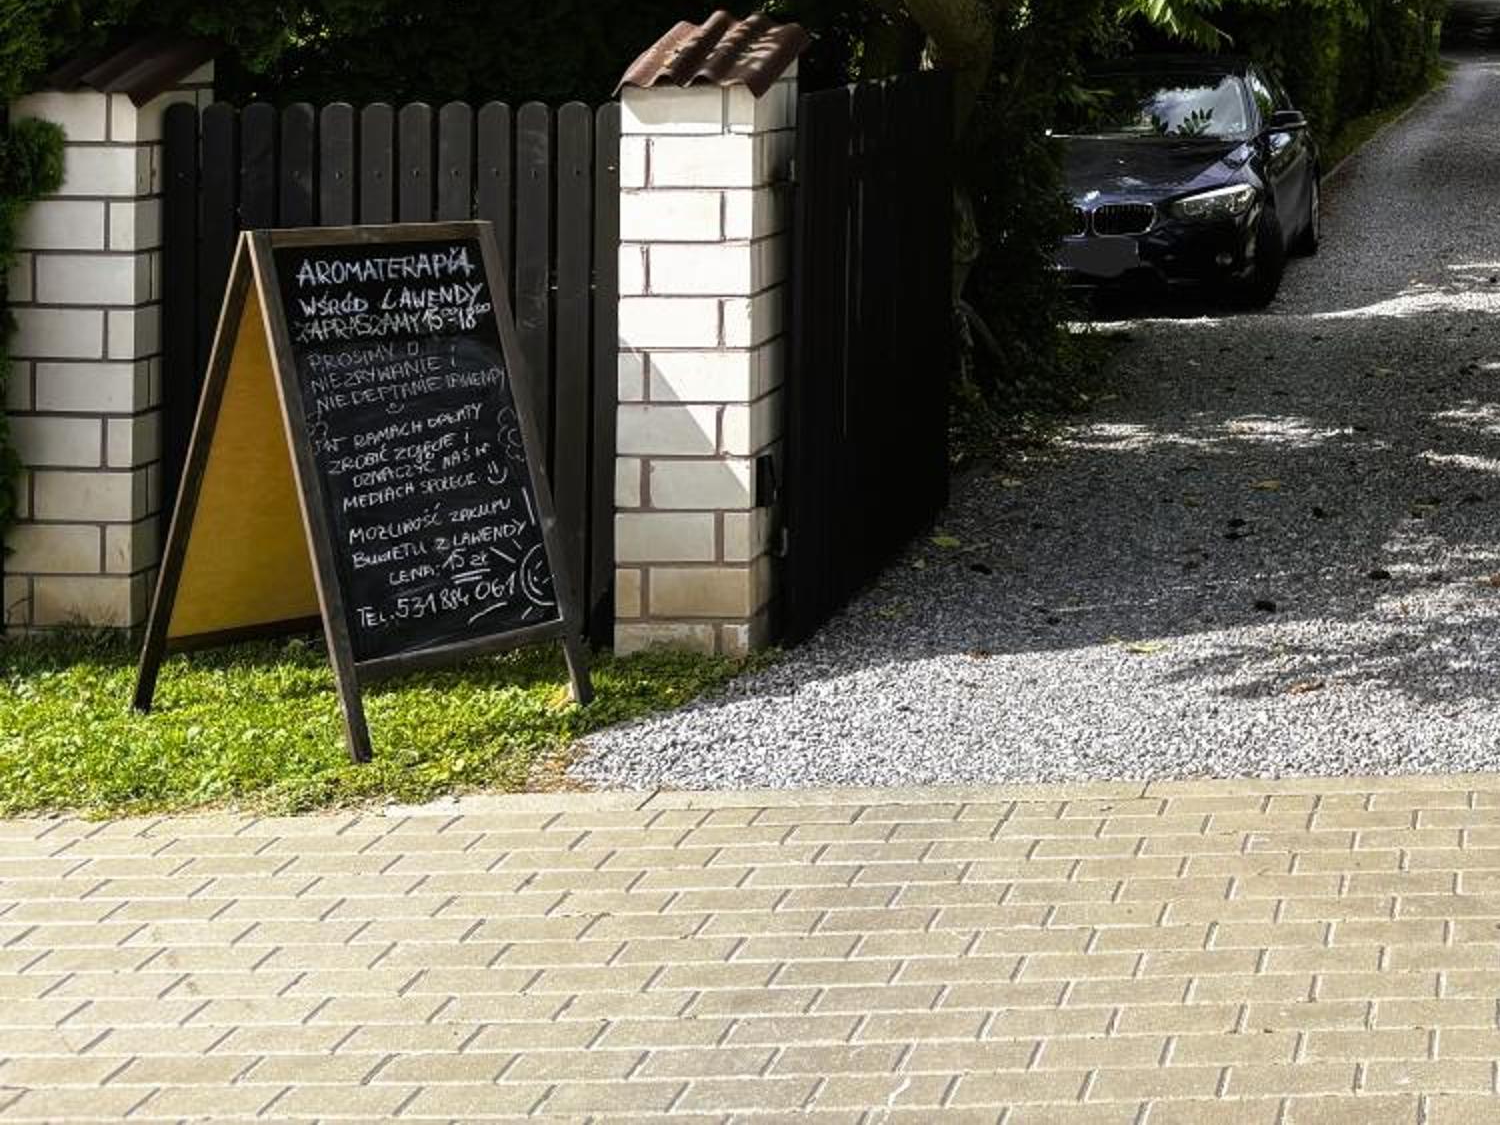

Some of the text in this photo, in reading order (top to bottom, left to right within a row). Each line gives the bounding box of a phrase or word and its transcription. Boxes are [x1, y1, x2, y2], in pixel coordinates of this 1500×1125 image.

[296, 246, 475, 288] AROMATERAPIA
[298, 281, 484, 317] WŚRÓD LAWENDY
[296, 311, 422, 343] ZAPRASZAMY
[306, 342, 393, 373] PROSIMY
[354, 420, 422, 450] RAMACH
[343, 482, 415, 512] MEDIACH
[453, 518, 527, 546] LAWENDY
